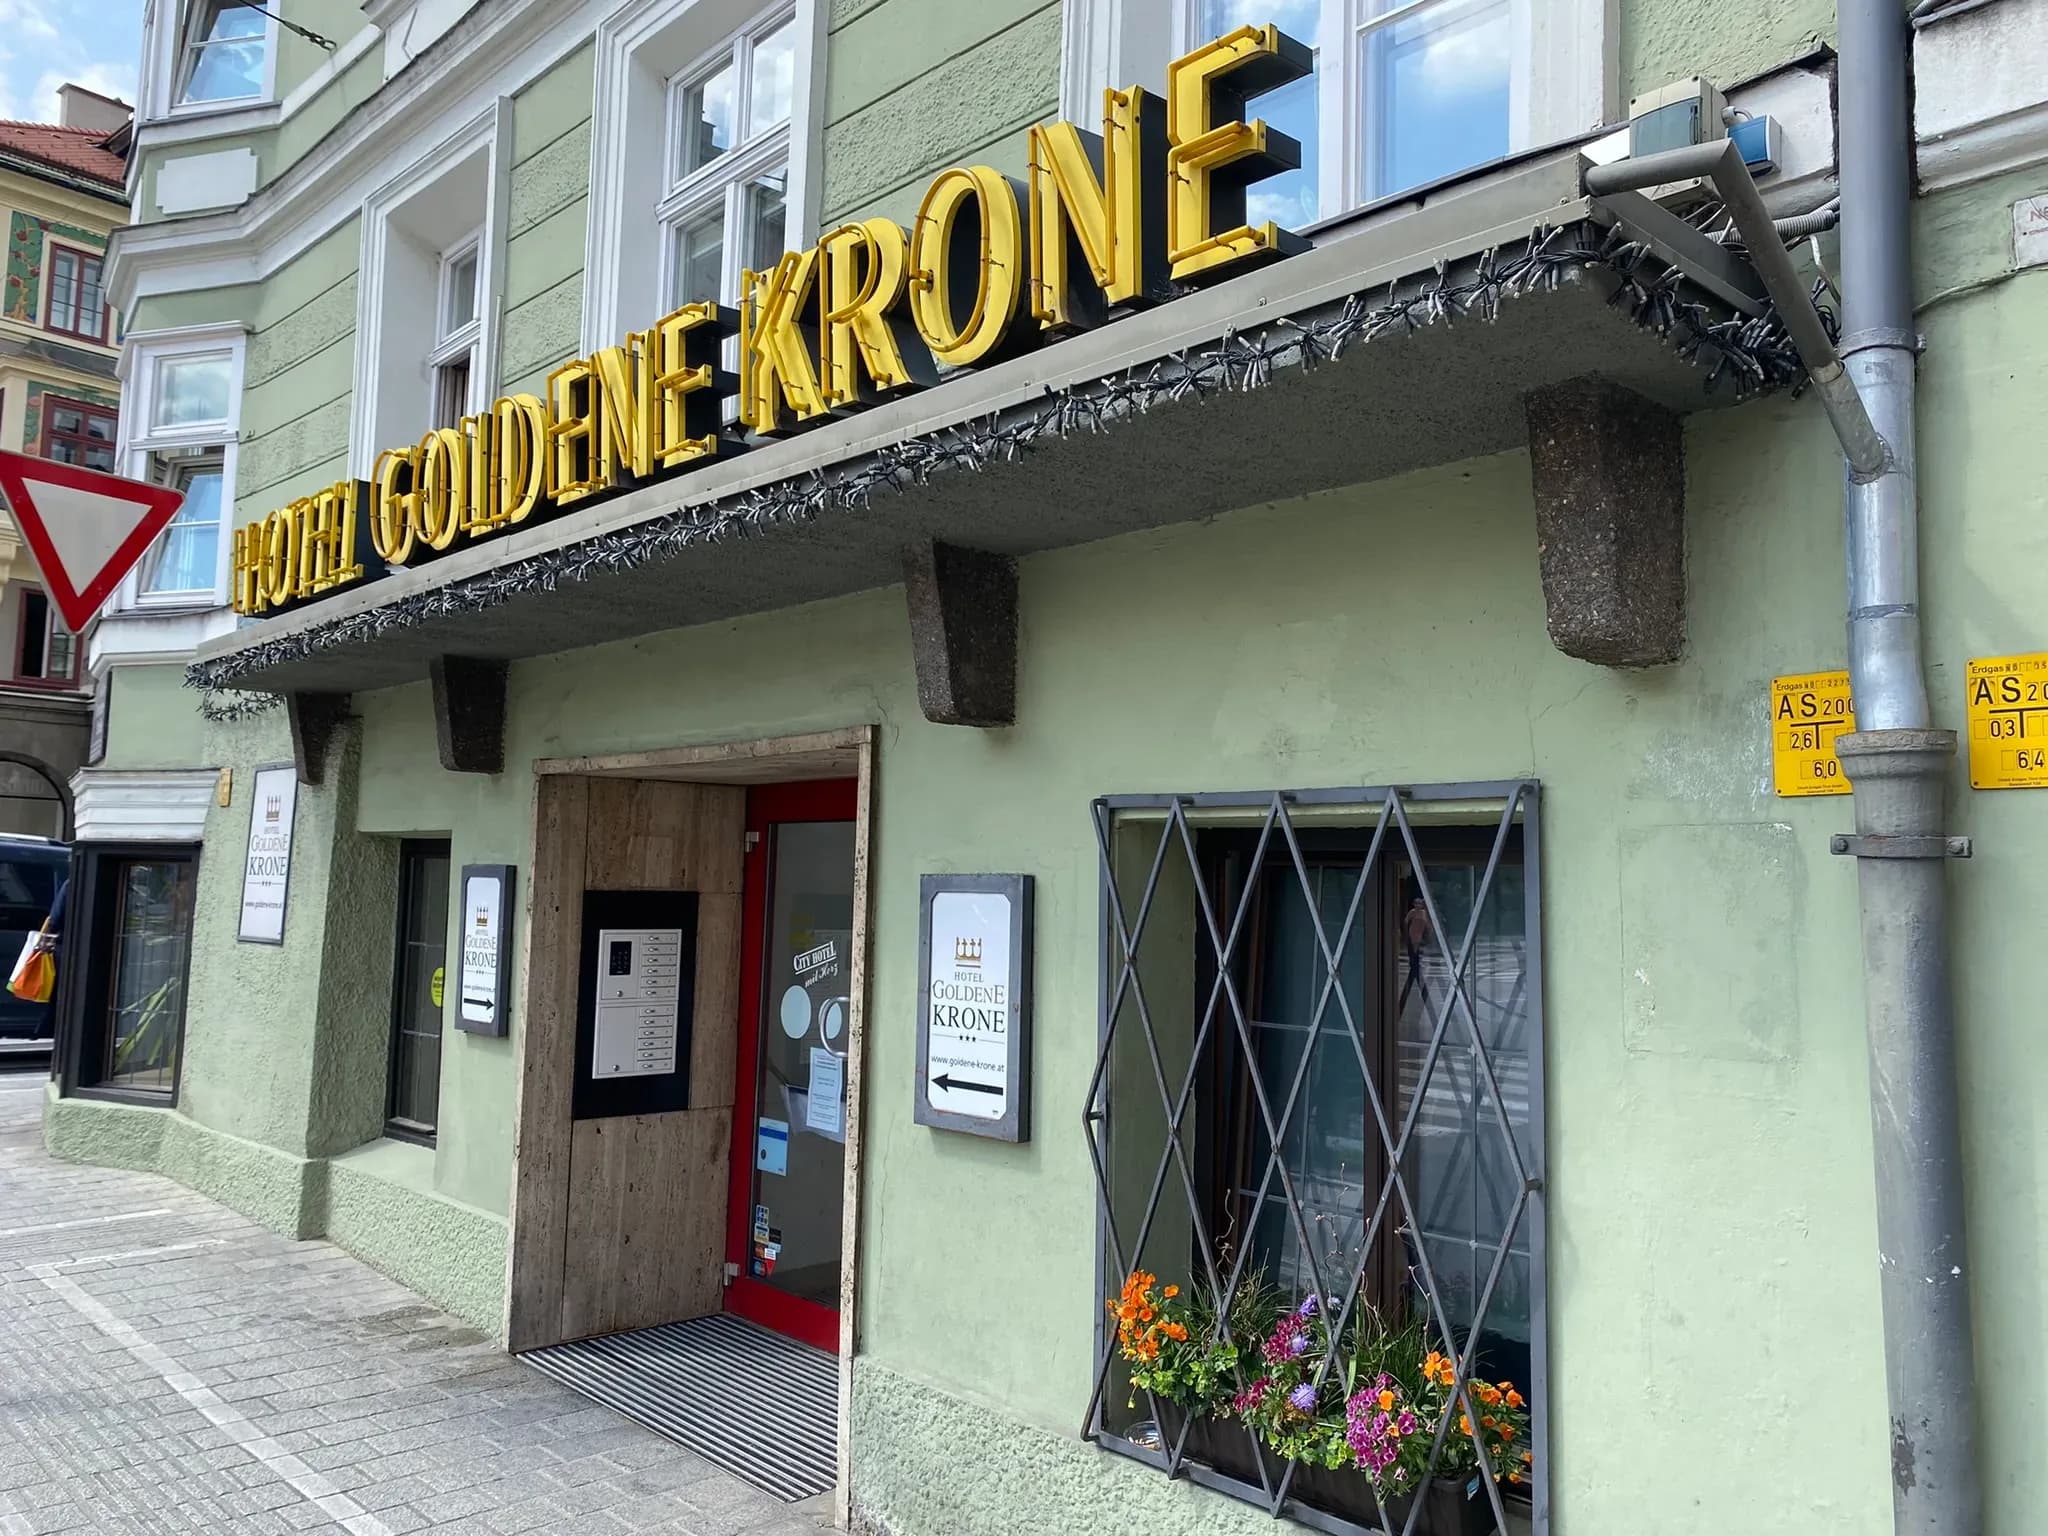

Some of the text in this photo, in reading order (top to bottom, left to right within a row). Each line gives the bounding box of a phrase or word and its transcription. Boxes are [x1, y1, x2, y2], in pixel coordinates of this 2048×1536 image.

[233, 22, 1282, 616] HOTEL GOLDENE KRONE
[1972, 664, 2004, 674] Erdgas
[1776, 682, 1803, 691] Erdgas
[1990, 719, 2015, 740] 0,3
[1791, 733, 1812, 751] 2,6
[1814, 761, 1837, 779] 6,0
[2018, 750, 2045, 771] 6,4
[248, 856, 287, 876] KRONE
[465, 950, 497, 969] KRONE
[812, 940, 837, 965] HOTEL
[954, 971, 984, 983] HOTEL
[932, 979, 1005, 1005] GOLDENE
[932, 1003, 1005, 1034] KRONE
[931, 1055, 1005, 1073] www.goldene-krone.at
